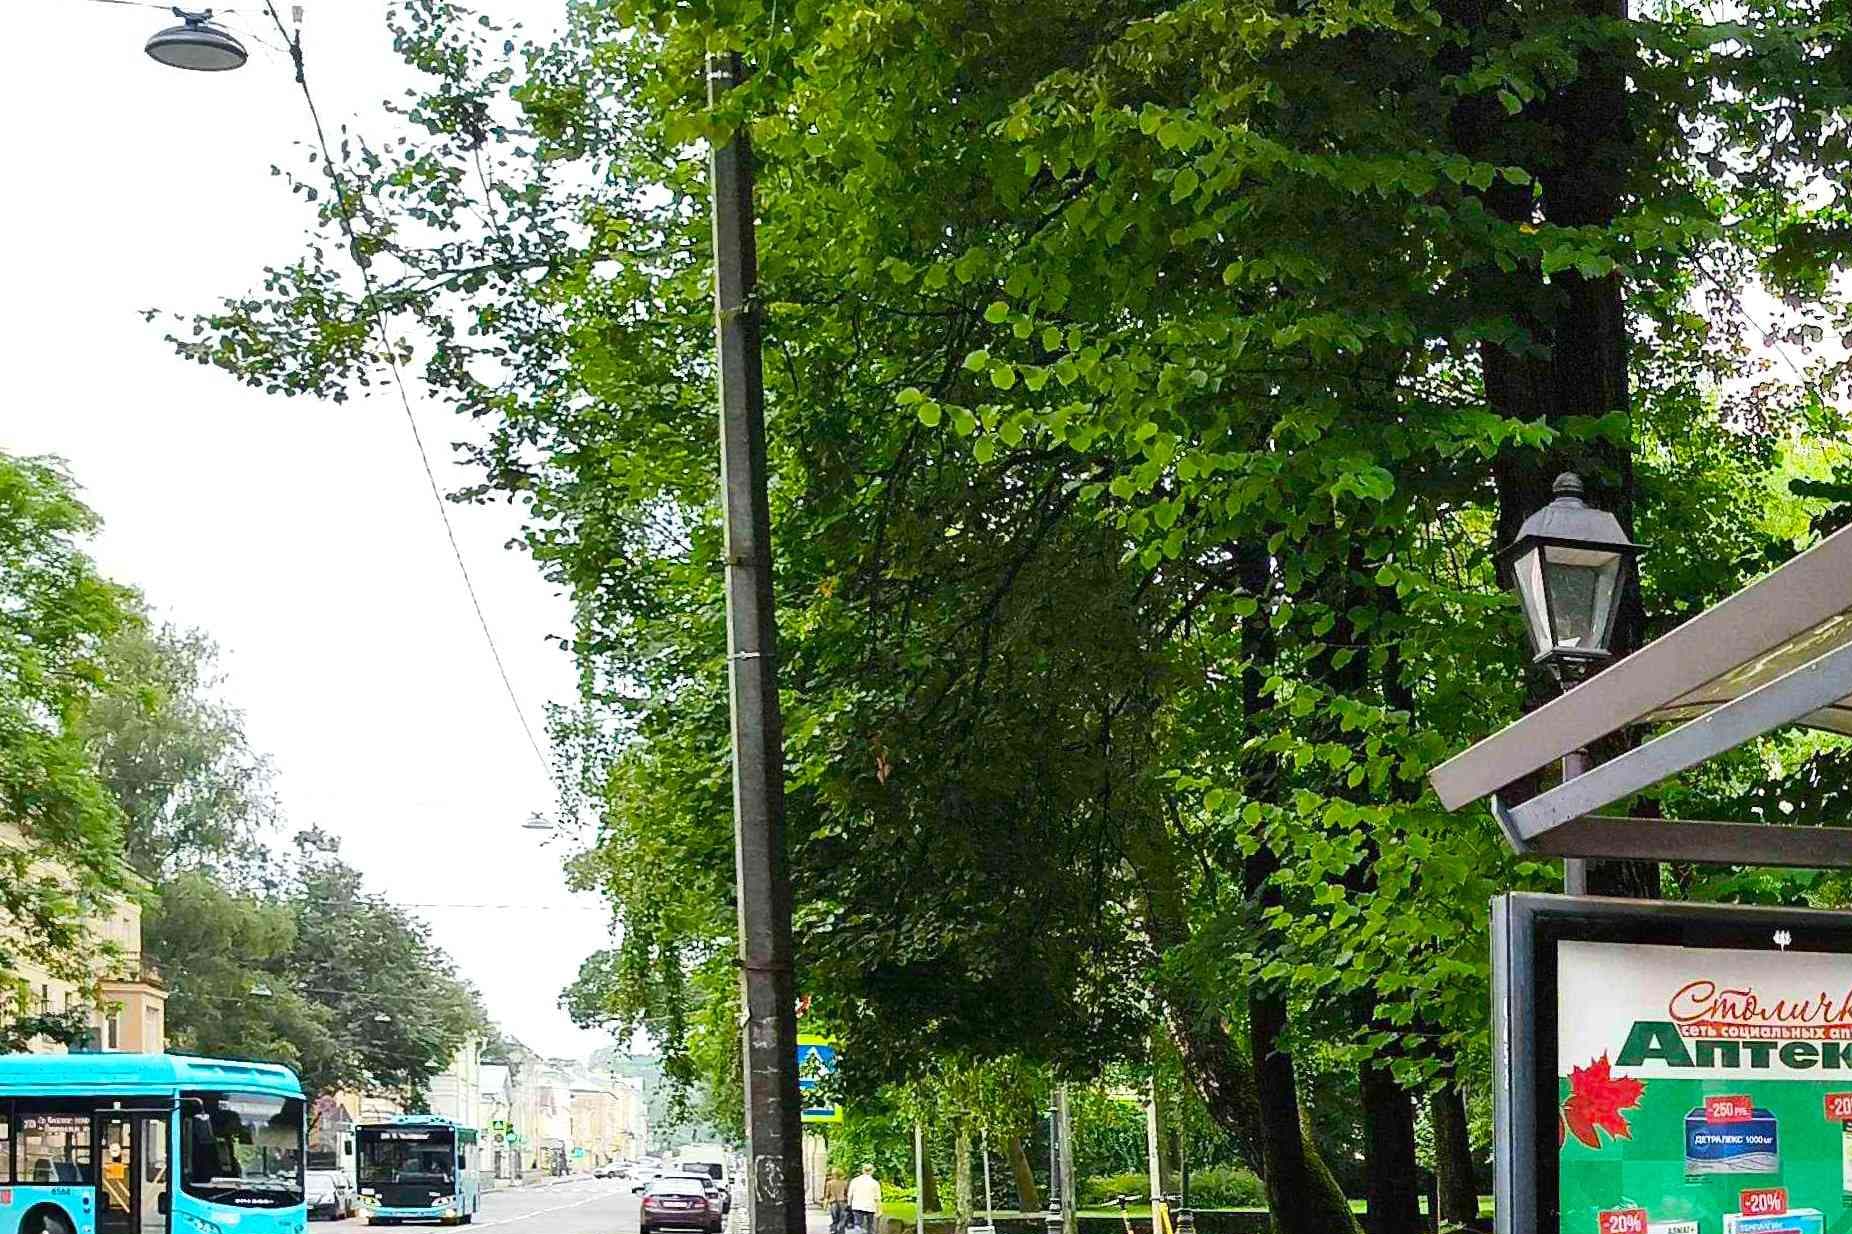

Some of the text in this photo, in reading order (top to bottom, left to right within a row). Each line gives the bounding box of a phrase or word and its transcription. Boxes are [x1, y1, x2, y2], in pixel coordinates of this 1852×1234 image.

[1681, 1025, 1716, 1038] сеть
[1721, 1026, 1825, 1040] социальных
[1745, 1194, 1781, 1212] -20%
[1603, 1215, 1641, 1234] -20%
